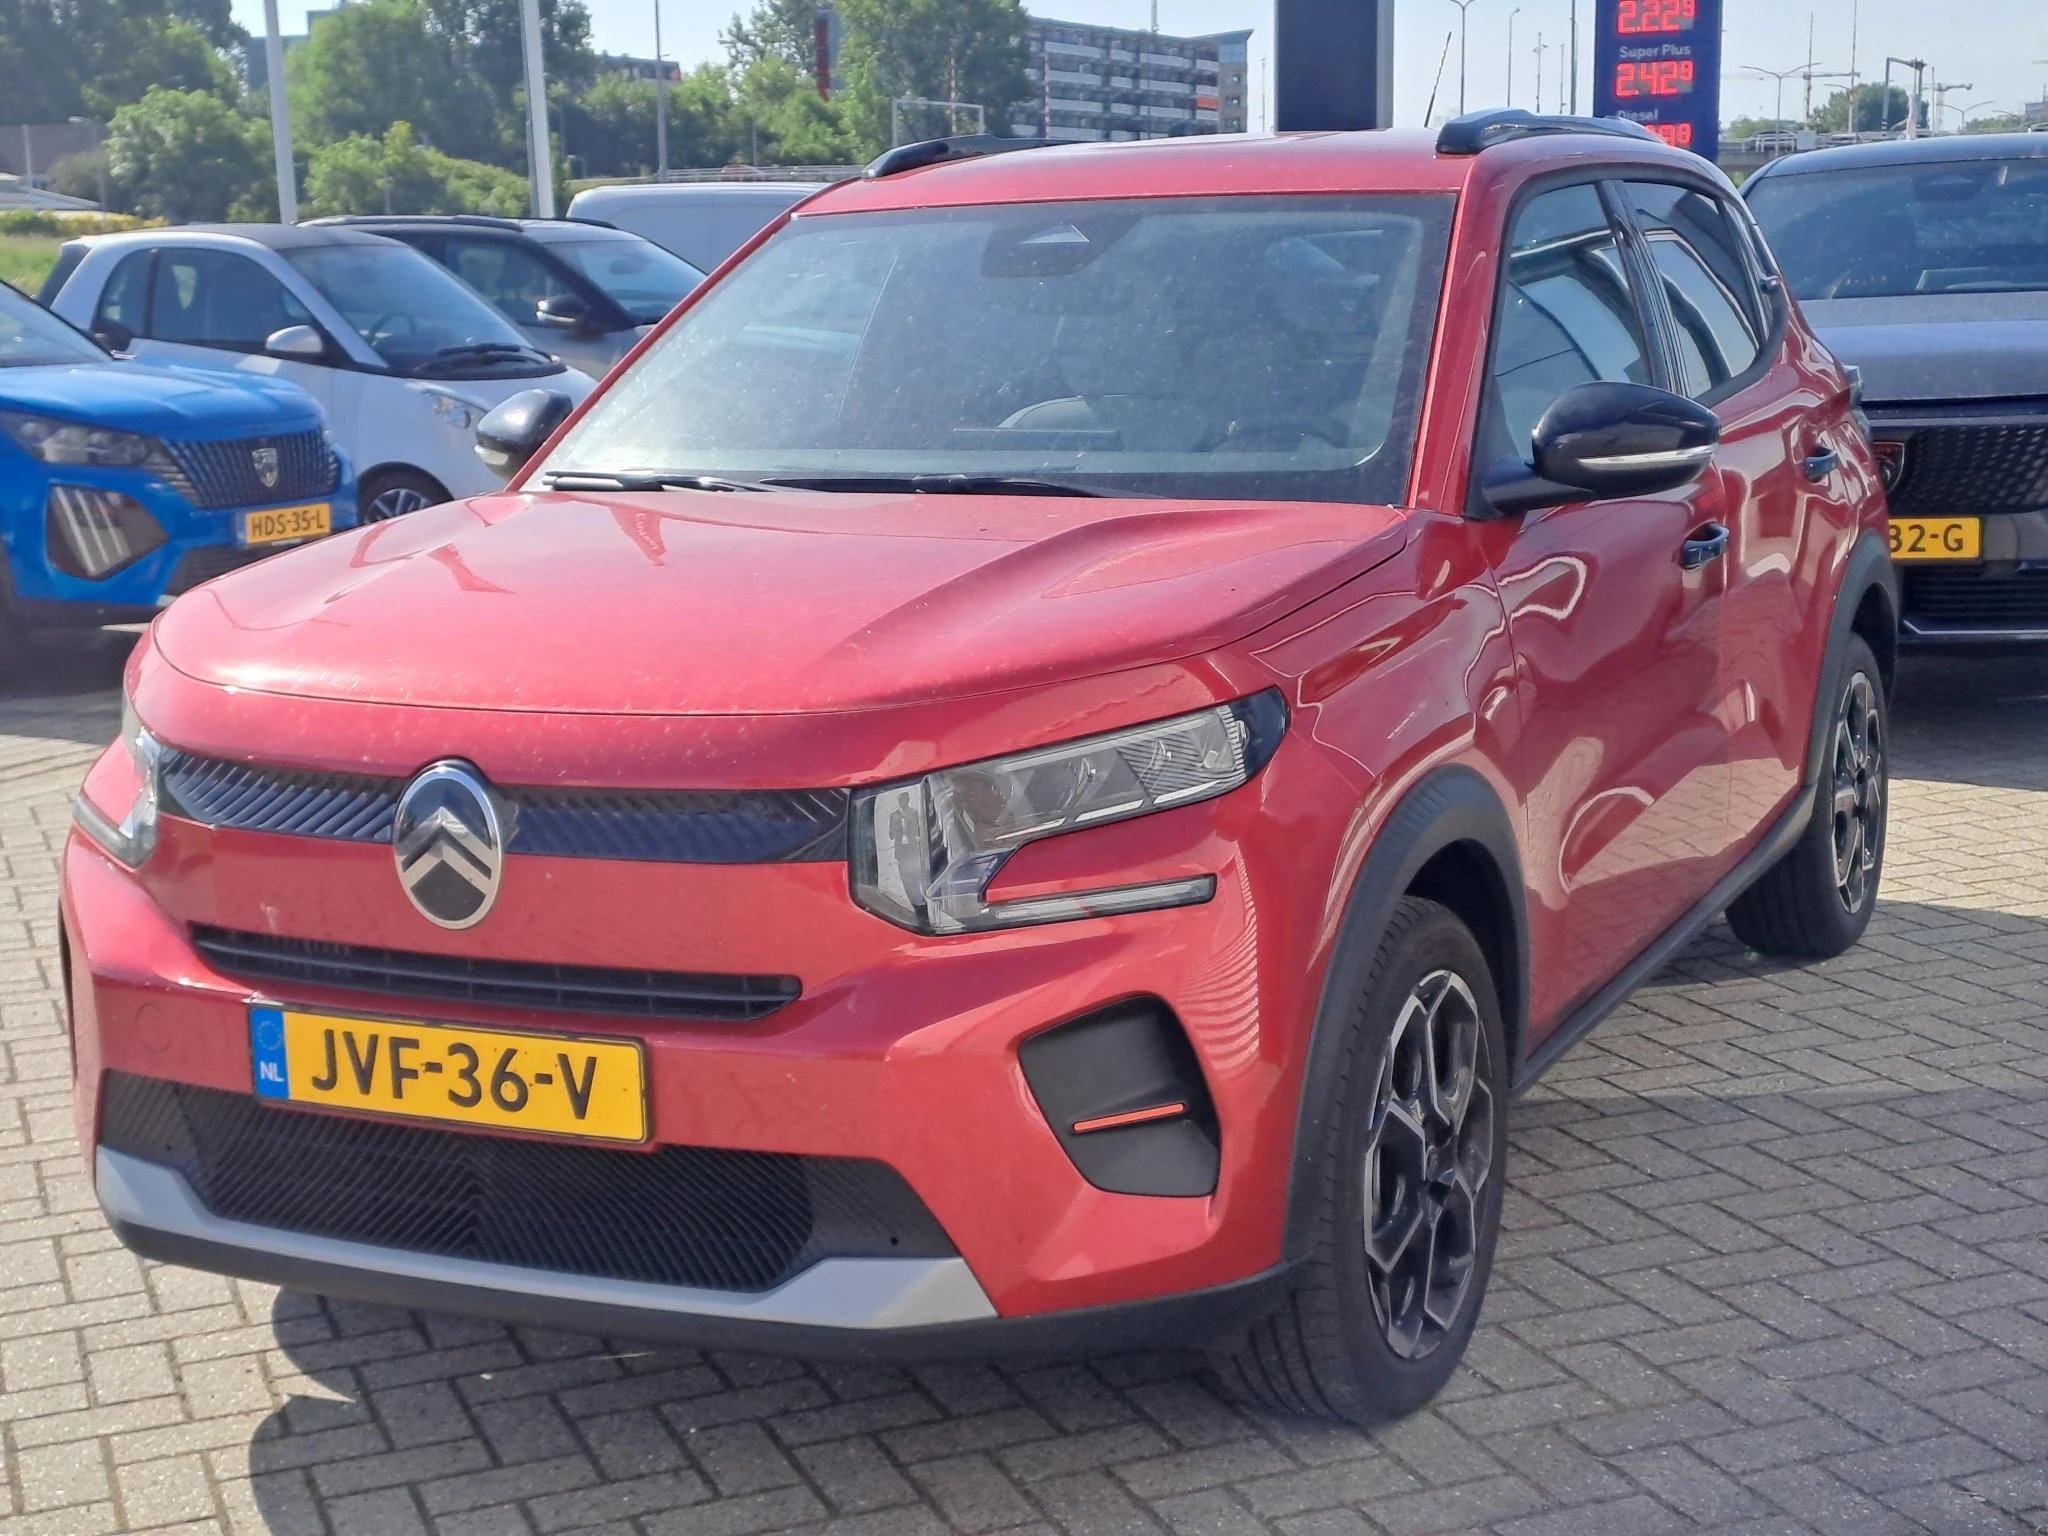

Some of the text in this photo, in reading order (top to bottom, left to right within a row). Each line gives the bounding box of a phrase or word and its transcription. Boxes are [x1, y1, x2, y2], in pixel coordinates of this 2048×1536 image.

[1620, 43, 1691, 59] Super Plus
[1615, 60, 1694, 97] 2.429
[1617, 108, 1659, 120] Diesel
[251, 509, 324, 537] HDS-35-L
[260, 1062, 284, 1083] NL
[311, 1028, 597, 1120] JVF-36-V
